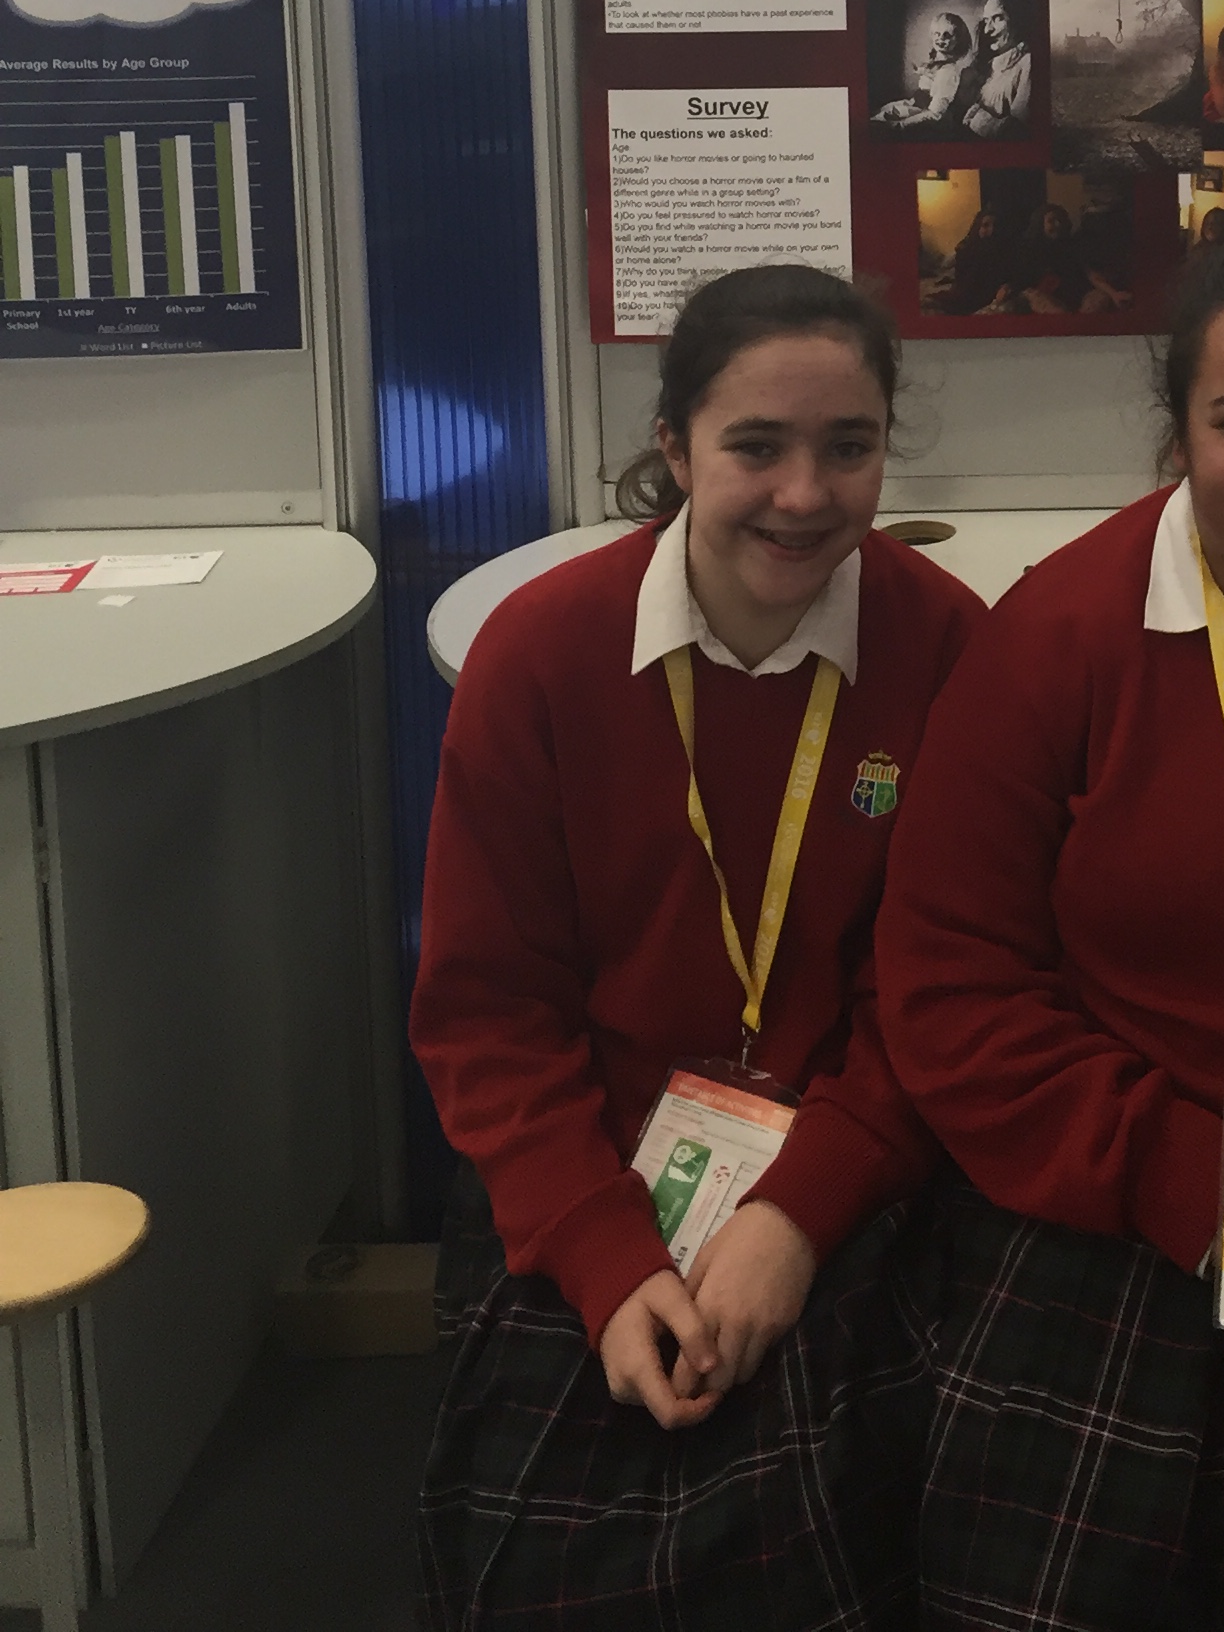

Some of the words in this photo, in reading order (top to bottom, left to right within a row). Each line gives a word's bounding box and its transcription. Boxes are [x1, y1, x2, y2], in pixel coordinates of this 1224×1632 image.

[0, 59, 48, 71] Average
[52, 58, 98, 69] Results
[102, 58, 117, 71] by
[121, 58, 145, 70] Age
[149, 57, 189, 69] Group
[687, 96, 769, 119] Survey
[611, 127, 636, 139] The
[639, 127, 703, 141] questions
[706, 129, 725, 139] we
[729, 126, 772, 138] asked:
